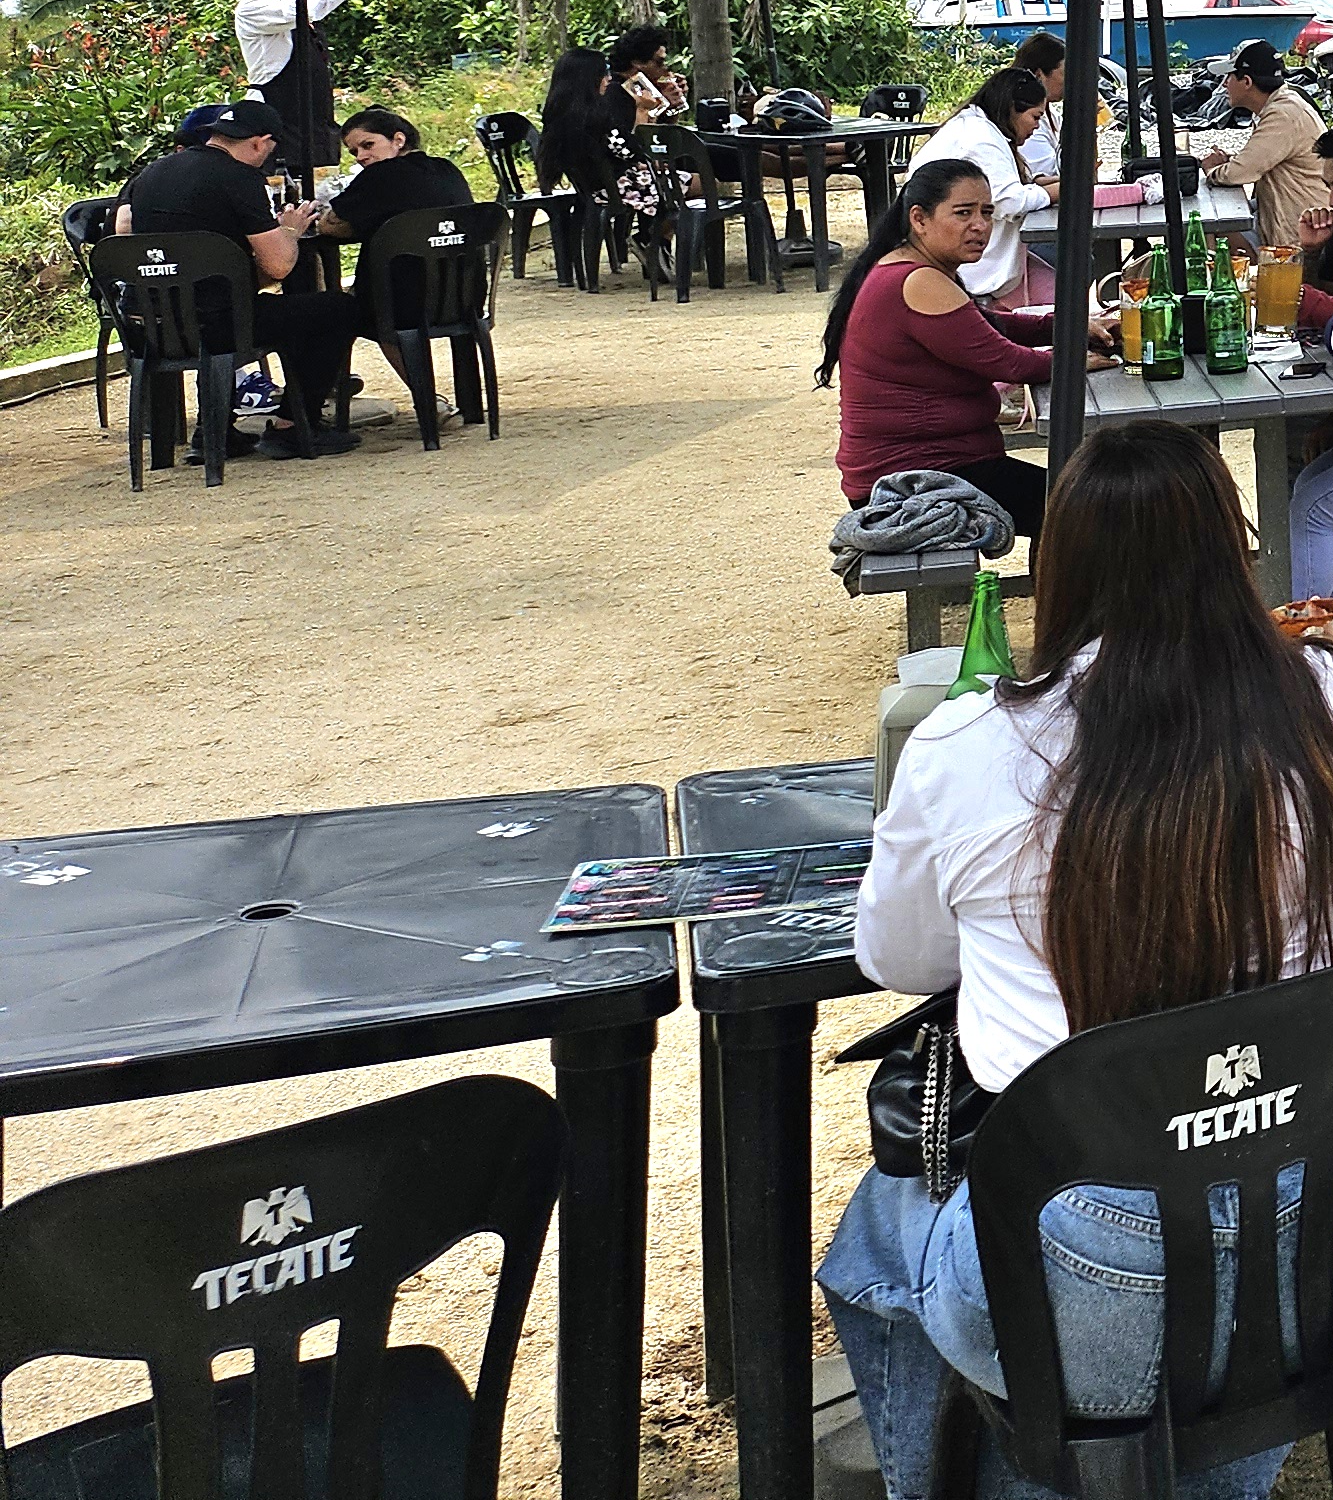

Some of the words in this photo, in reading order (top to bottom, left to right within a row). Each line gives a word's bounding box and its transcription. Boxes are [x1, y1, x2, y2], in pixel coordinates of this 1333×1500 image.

[427, 233, 467, 248] TECATE
[137, 263, 179, 277] TECATE
[1165, 1083, 1299, 1151] TECATE
[190, 1226, 360, 1311] TECATE
